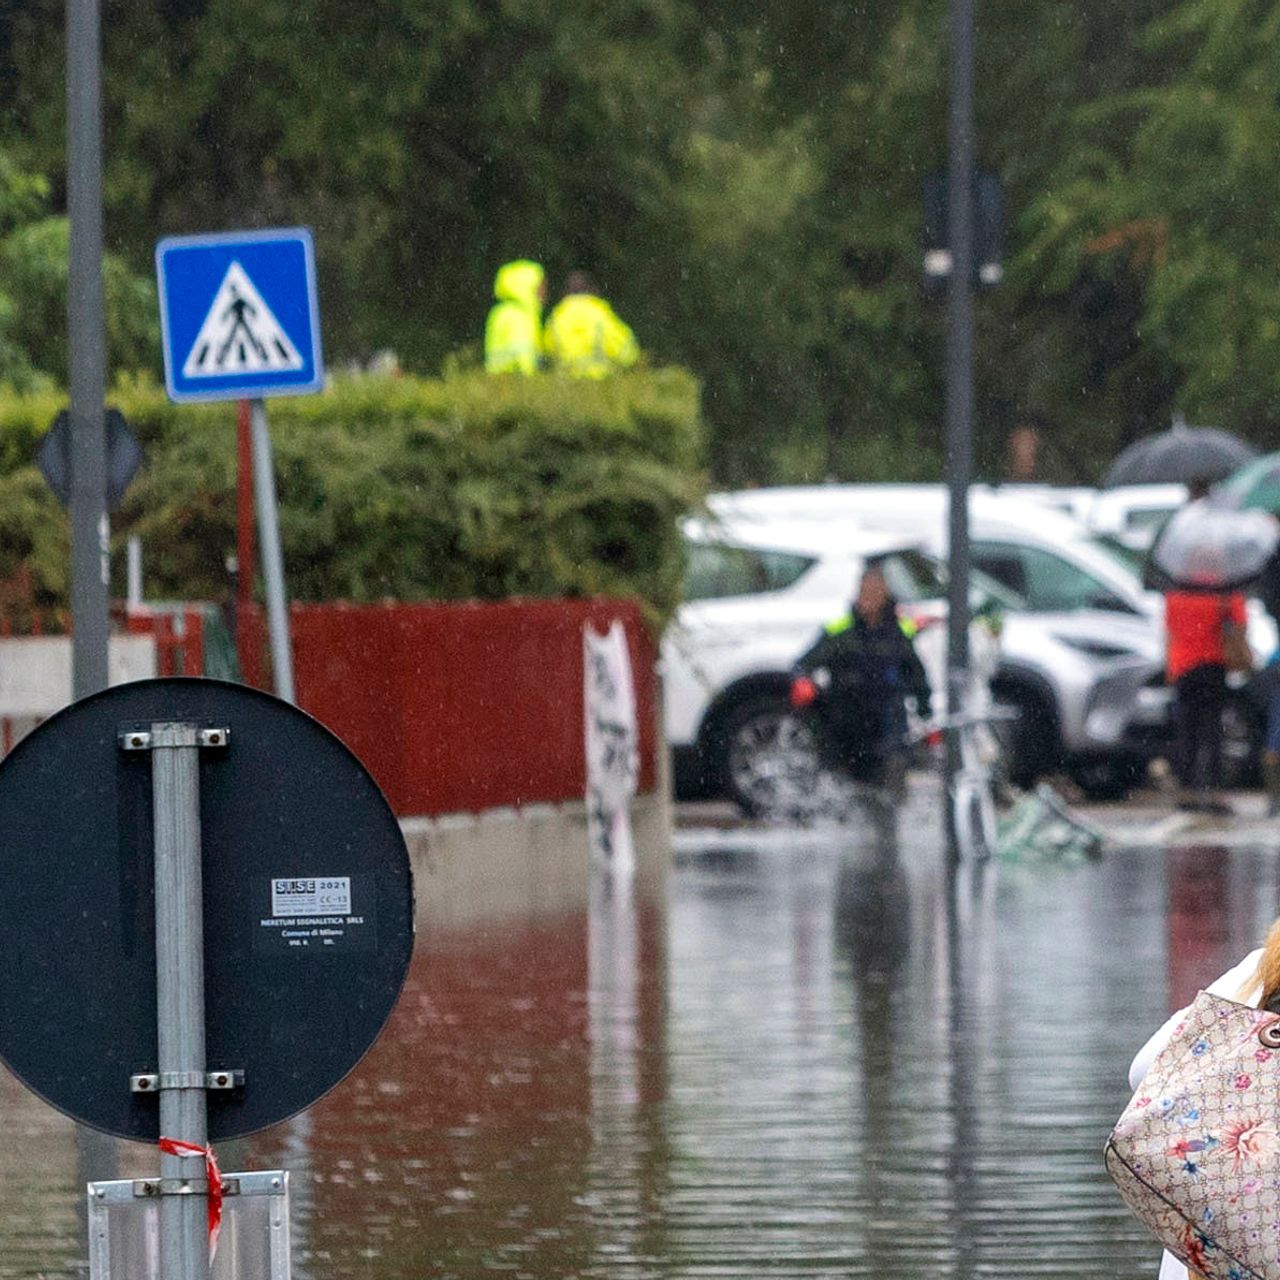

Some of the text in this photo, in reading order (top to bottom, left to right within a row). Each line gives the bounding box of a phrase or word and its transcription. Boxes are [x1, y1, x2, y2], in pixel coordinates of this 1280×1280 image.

[319, 881, 346, 889] 2021
[281, 928, 344, 937] Comune di Milano
